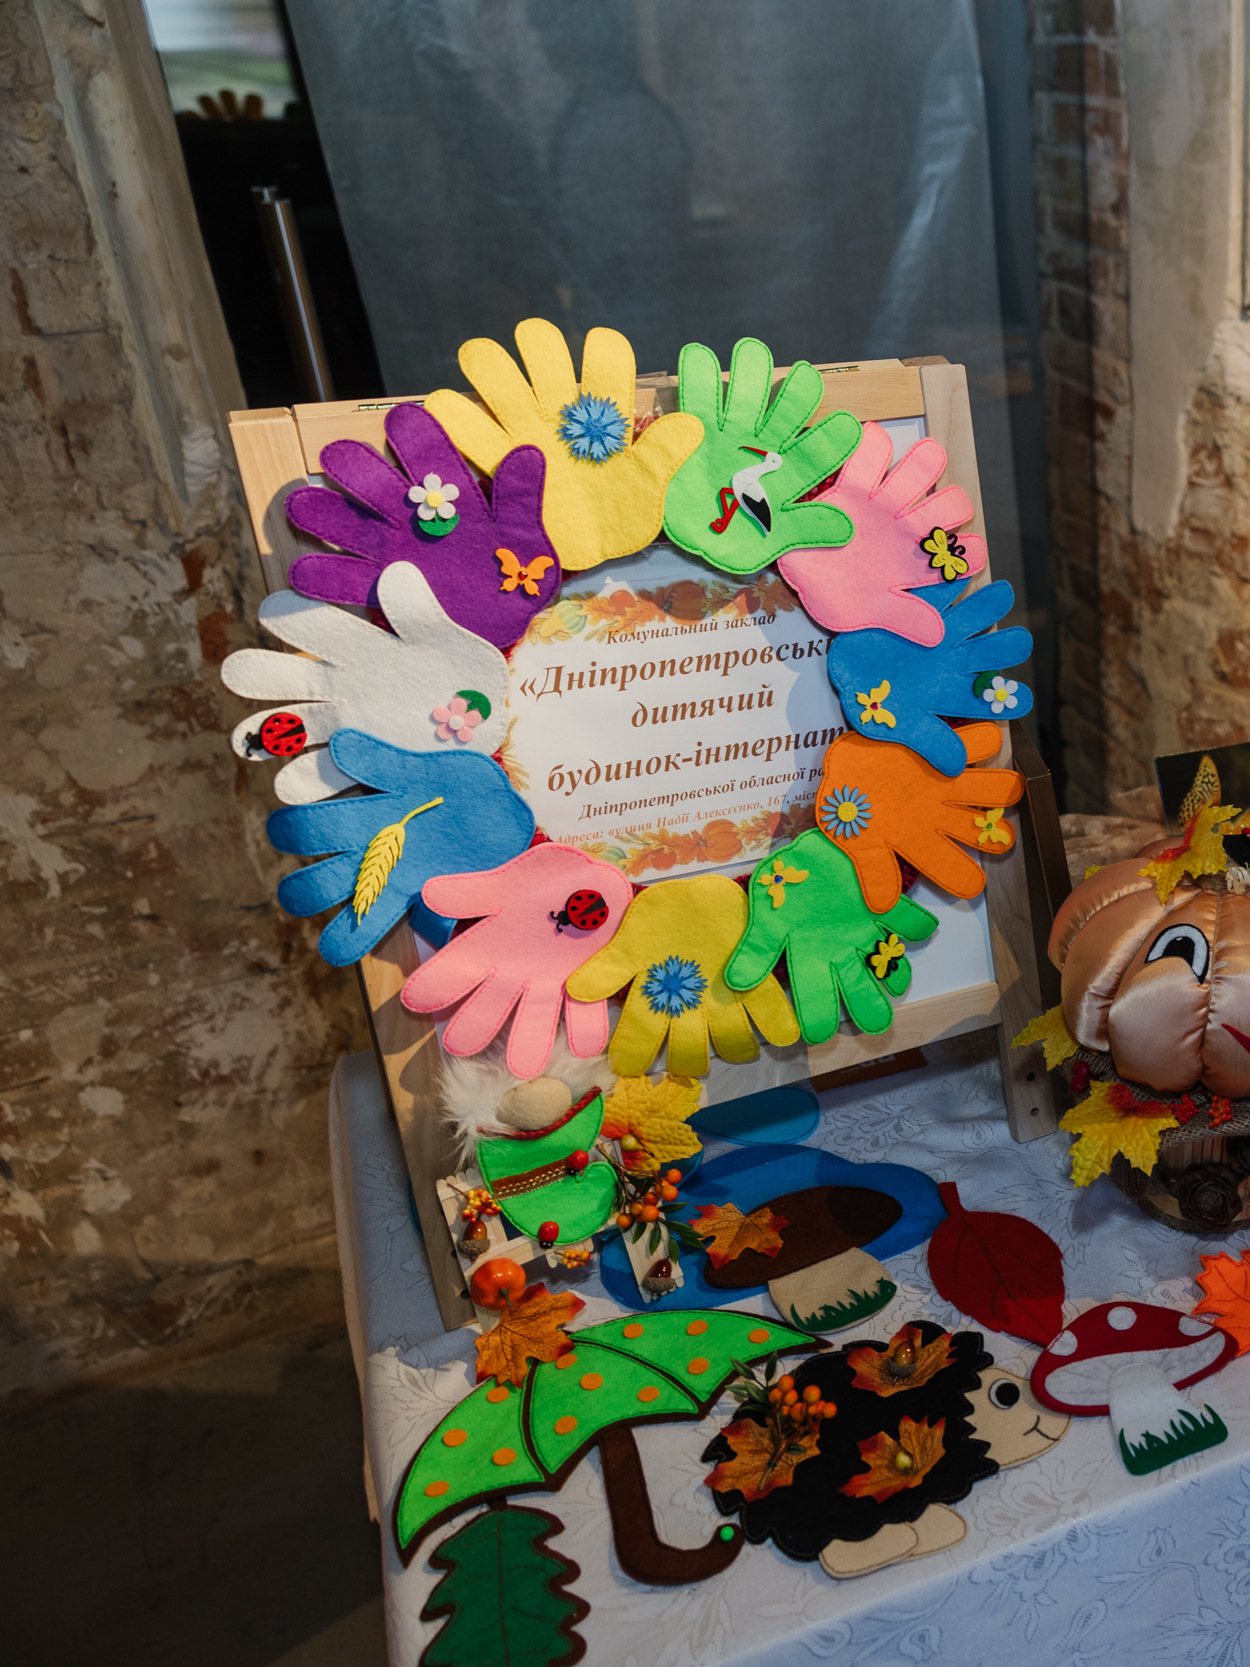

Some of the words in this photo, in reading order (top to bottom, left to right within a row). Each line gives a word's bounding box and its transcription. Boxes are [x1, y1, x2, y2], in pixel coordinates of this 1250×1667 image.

[605, 616, 719, 646] Комунальний
[722, 611, 776, 631] заклад
[630, 682, 775, 728] дитячий
[547, 725, 845, 797] будинок-інтернат
[556, 830, 605, 847] Адреса:
[608, 821, 652, 839] вулиця
[656, 812, 691, 829] Надії
[691, 801, 764, 823] Алексєєнко,
[767, 793, 790, 807] 167,
[578, 779, 737, 822] Дніпропетровської
[739, 766, 806, 790] обласної
